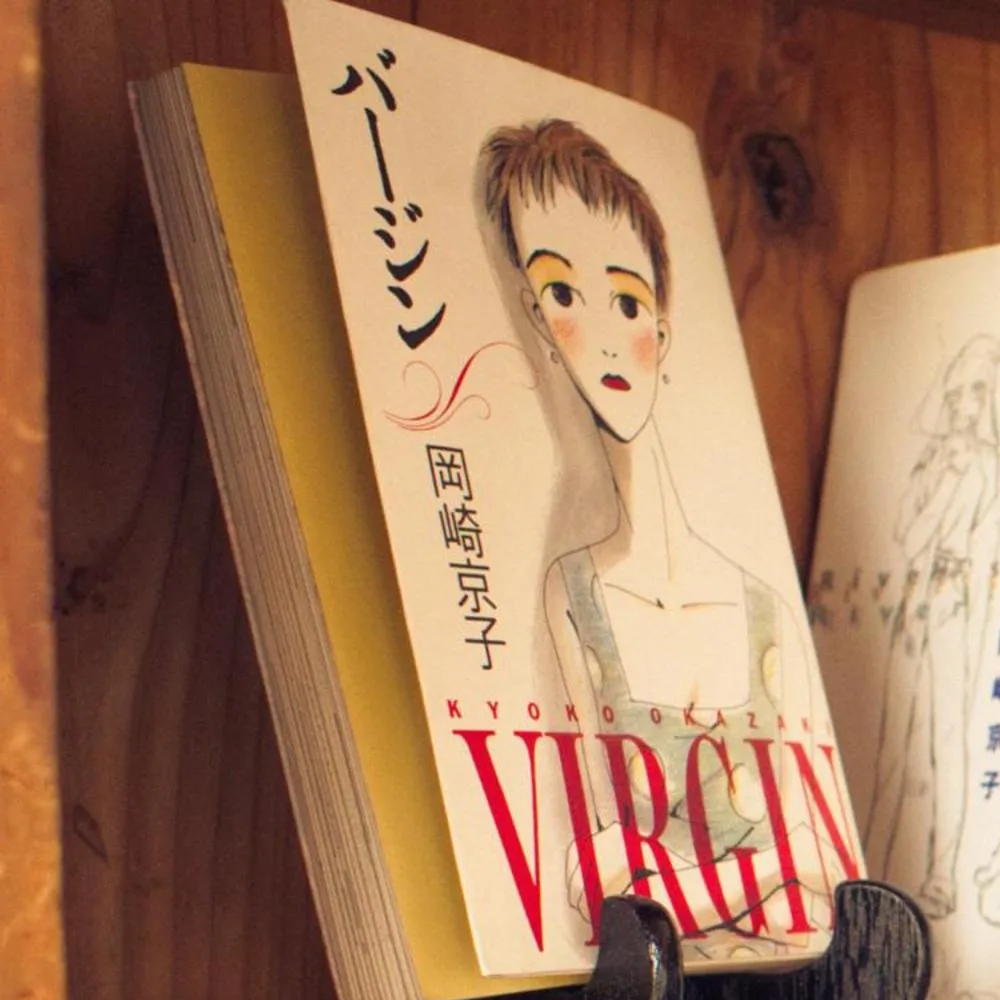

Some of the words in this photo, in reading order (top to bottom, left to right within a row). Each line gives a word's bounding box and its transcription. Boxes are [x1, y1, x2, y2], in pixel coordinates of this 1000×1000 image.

[331, 48, 446, 350] バージン
[426, 444, 506, 670] 岡崎京子
[447, 699, 615, 723] KYOKO
[452, 729, 860, 952] VIRGIN
